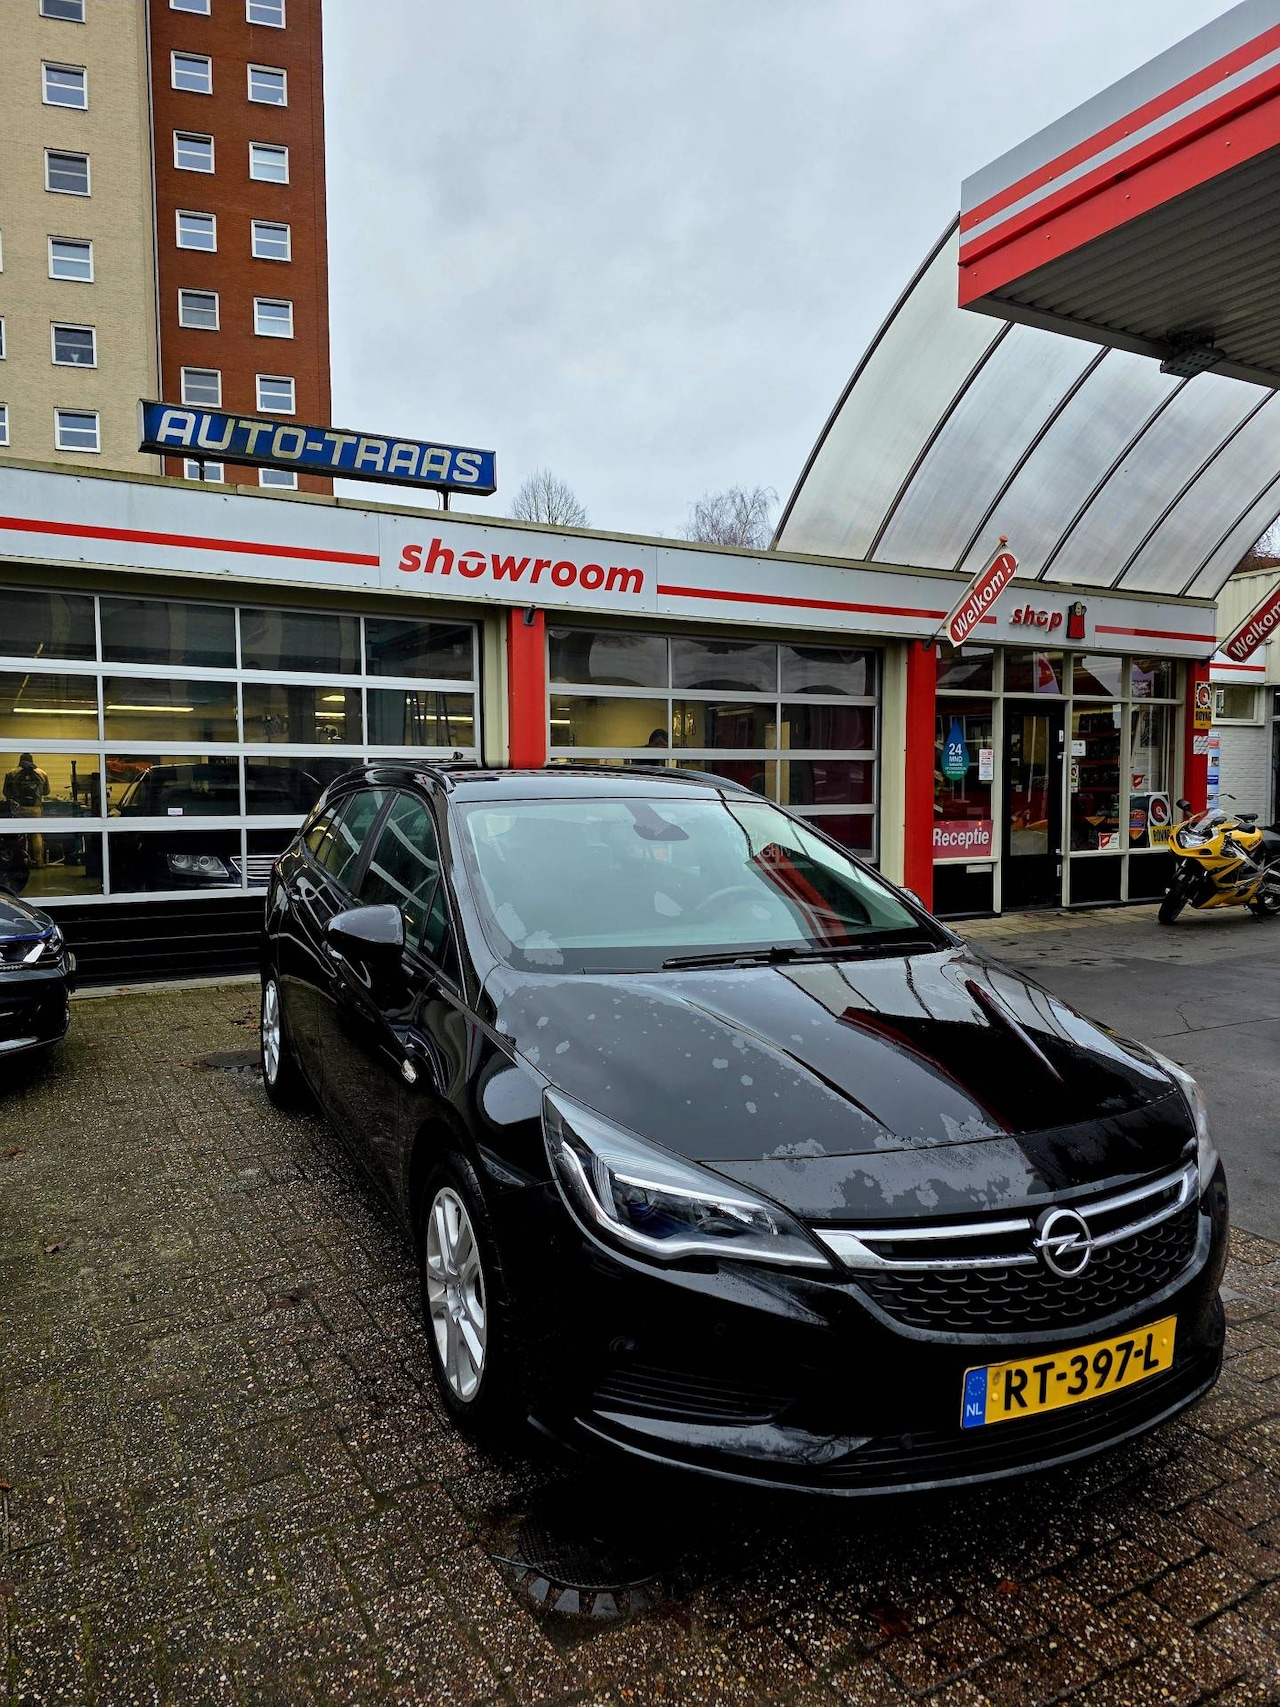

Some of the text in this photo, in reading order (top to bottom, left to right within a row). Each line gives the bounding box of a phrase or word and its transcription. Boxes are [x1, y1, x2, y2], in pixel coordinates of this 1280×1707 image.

[155, 409, 483, 483] AUTO-TRAAS
[398, 538, 645, 595] showroom
[952, 573, 1006, 637] Welkom
[1010, 604, 1063, 632] shop
[1195, 710, 1212, 721] BOVAG
[948, 742, 962, 755] 24
[933, 827, 990, 849] Receptie
[1003, 1333, 1159, 1411] RT-397-L
[966, 1404, 983, 1417] NL
